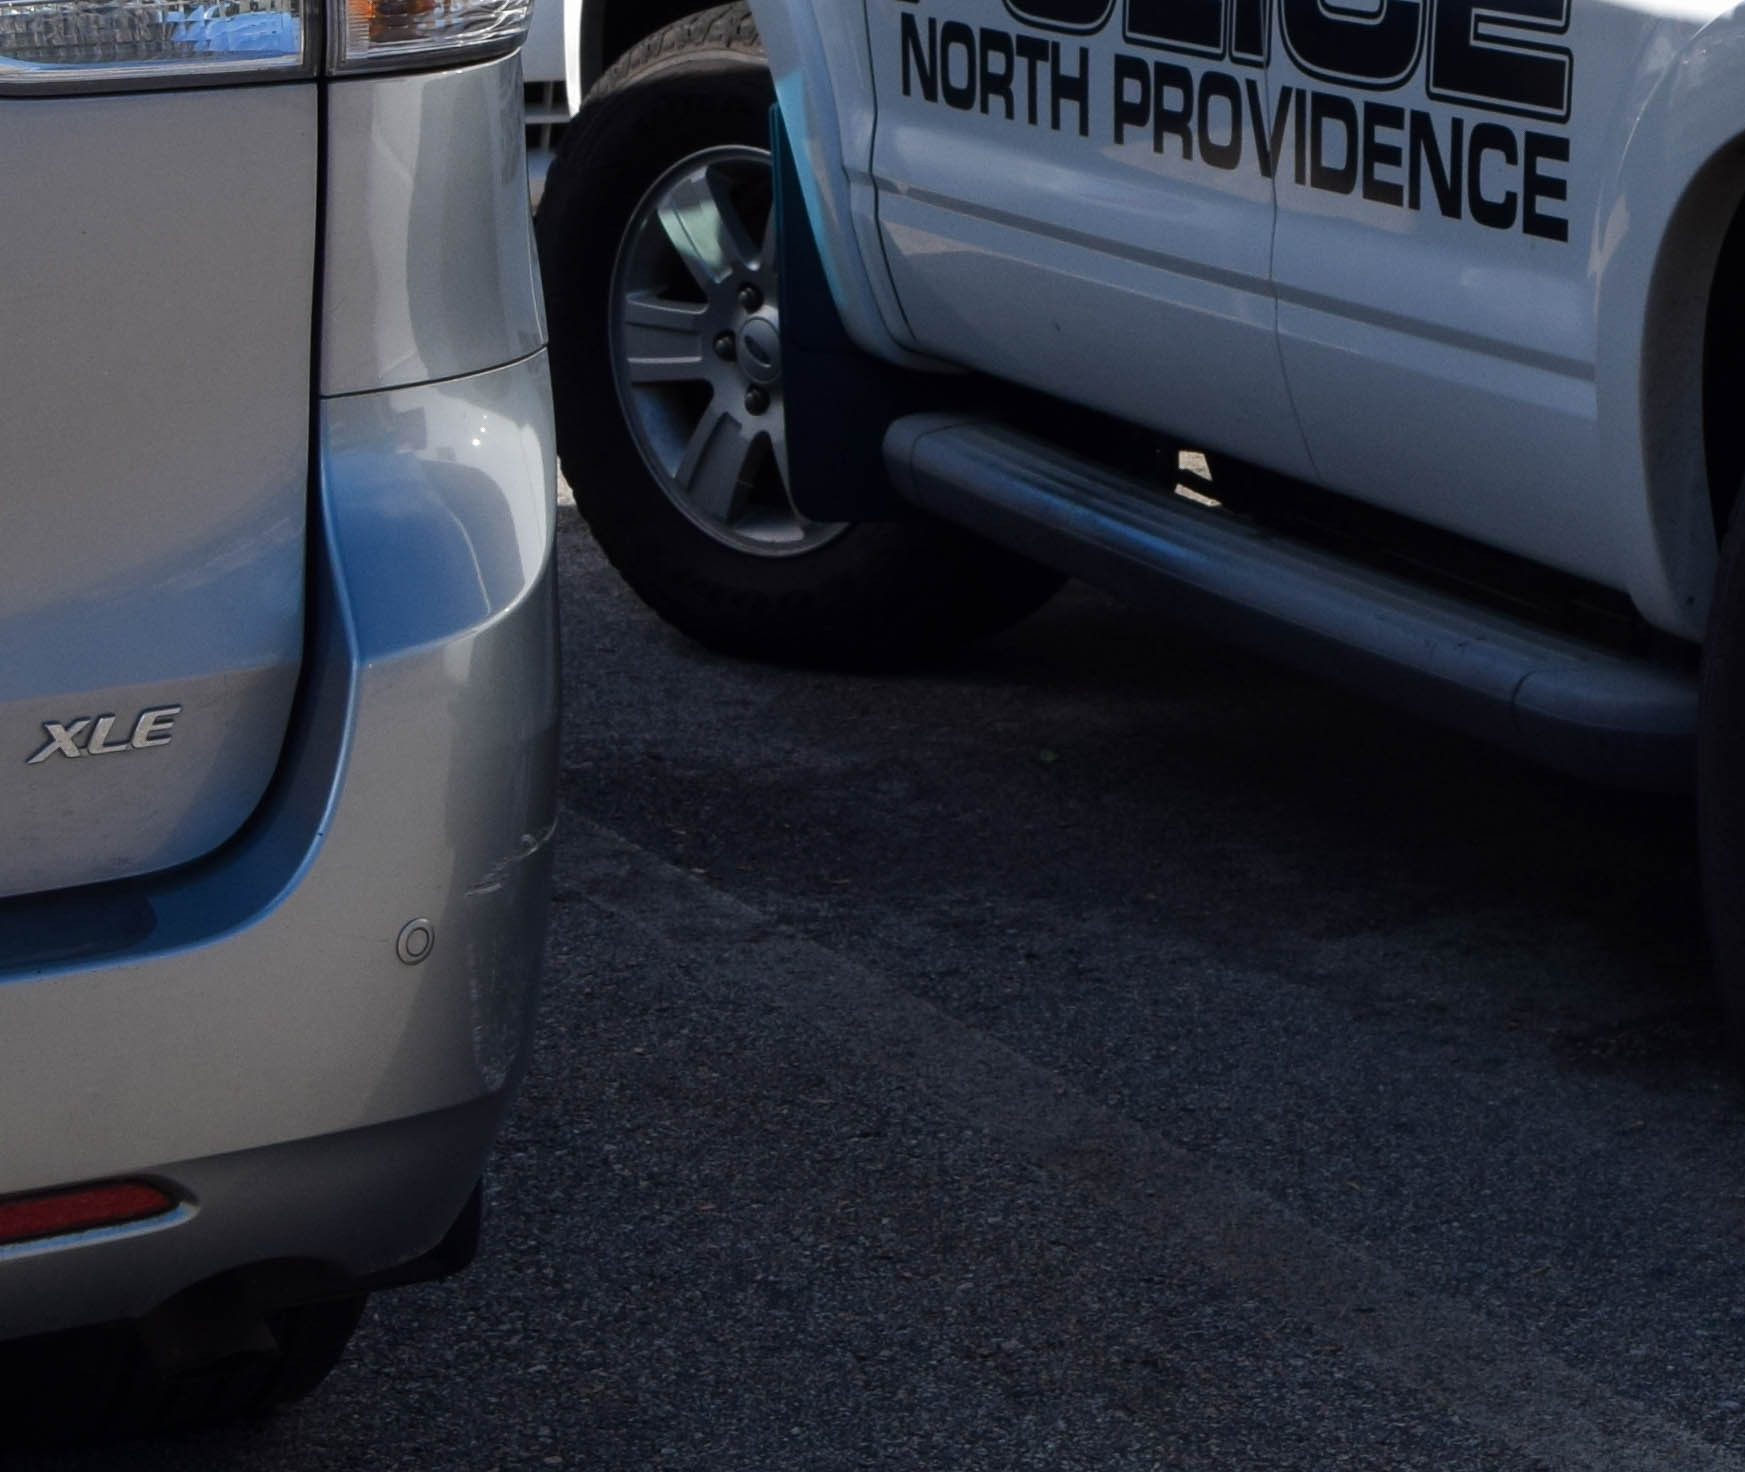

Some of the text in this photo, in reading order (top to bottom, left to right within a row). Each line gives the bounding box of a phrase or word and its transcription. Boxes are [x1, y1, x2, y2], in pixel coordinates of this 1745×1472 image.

[901, 12, 1571, 243] NORTH PROVIDENCE
[26, 703, 183, 765] XLE
